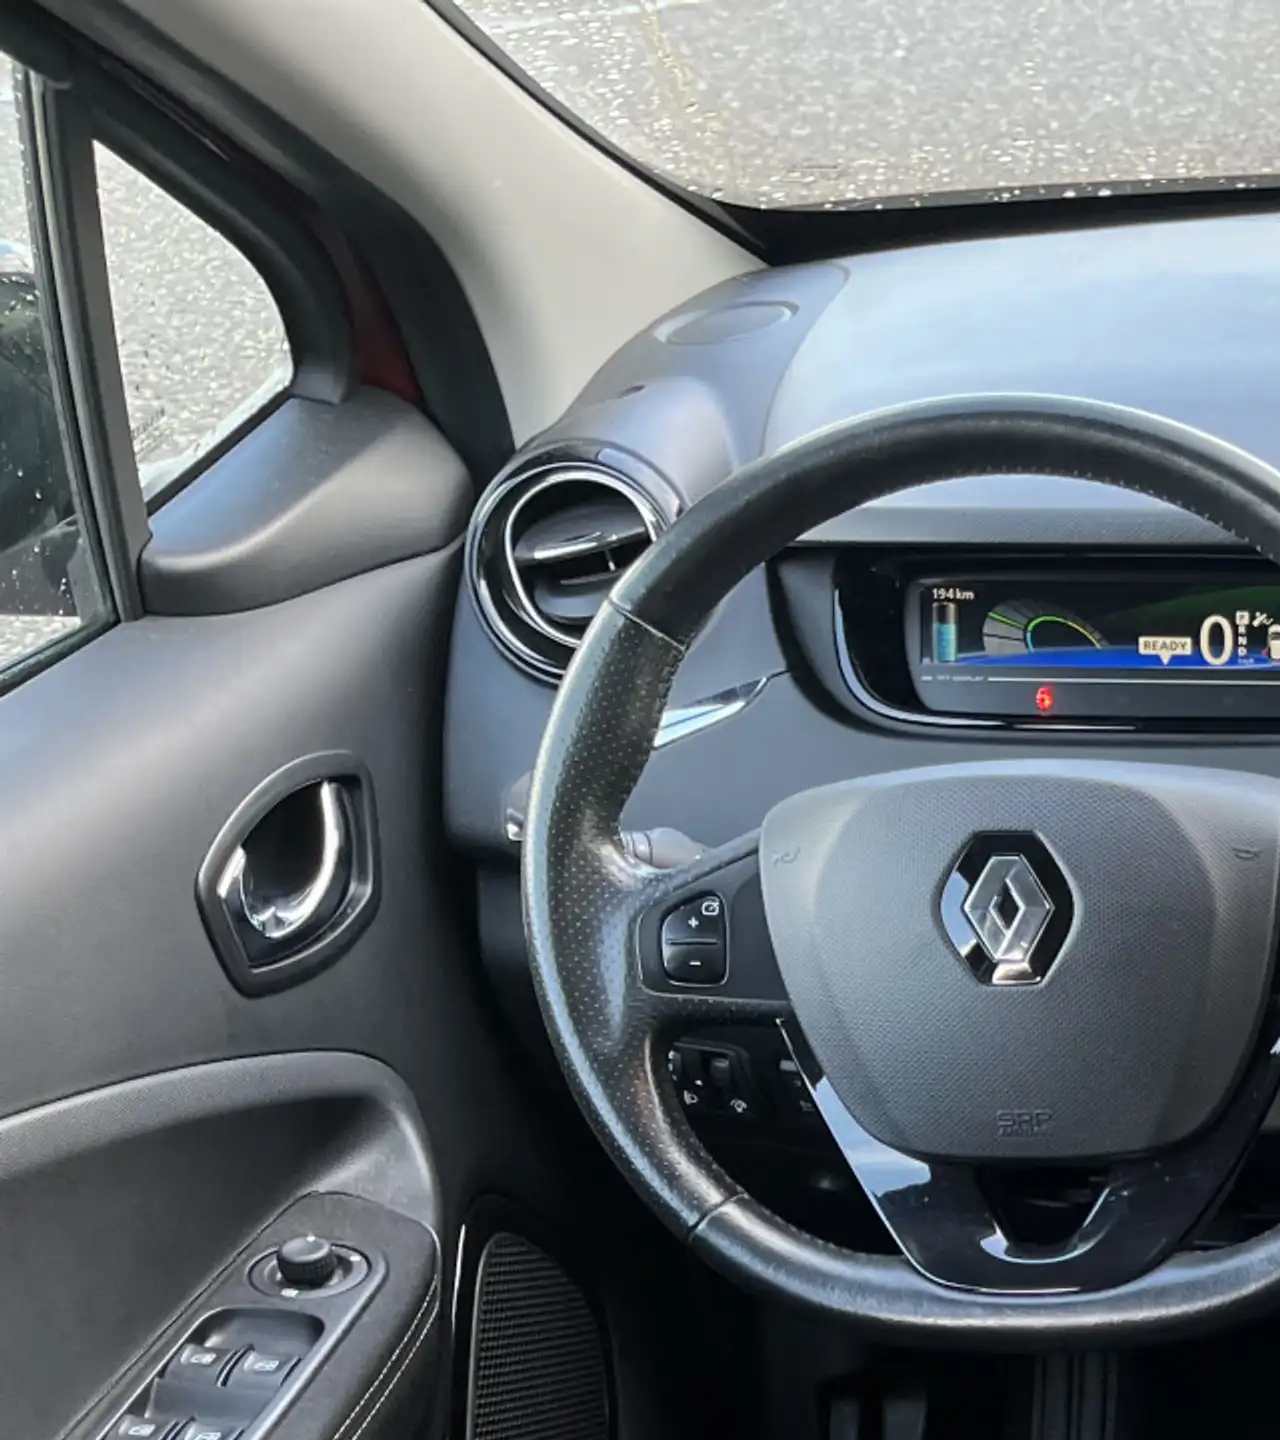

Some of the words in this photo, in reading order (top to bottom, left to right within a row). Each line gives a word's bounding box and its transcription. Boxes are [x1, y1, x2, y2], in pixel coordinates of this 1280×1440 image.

[932, 588, 955, 600] 194
[955, 588, 975, 600] km
[1143, 639, 1188, 651] READY
[1200, 614, 1234, 665] 0
